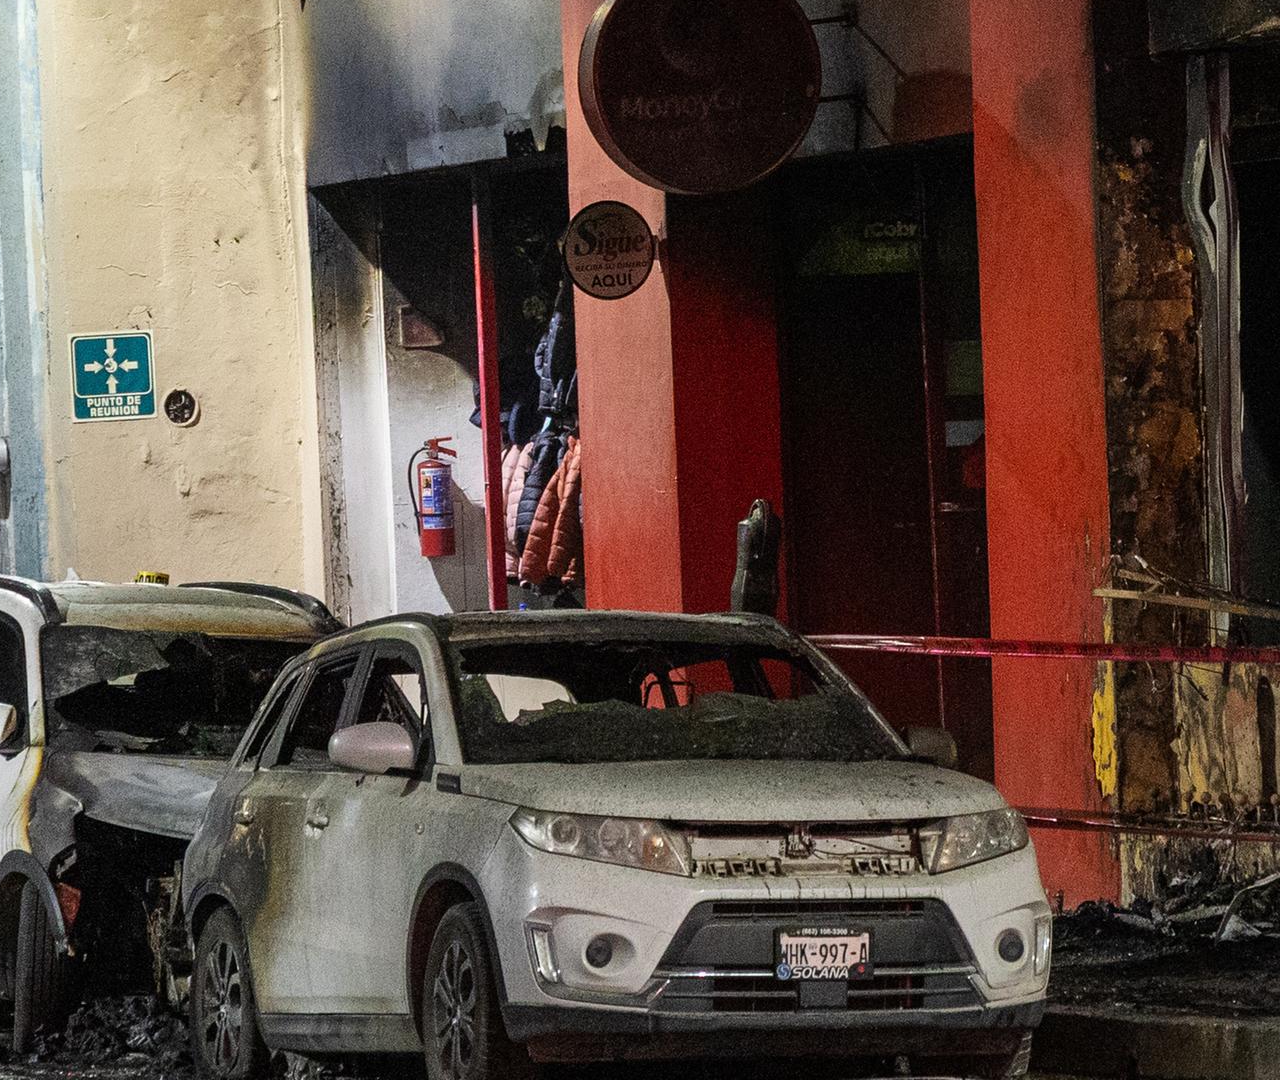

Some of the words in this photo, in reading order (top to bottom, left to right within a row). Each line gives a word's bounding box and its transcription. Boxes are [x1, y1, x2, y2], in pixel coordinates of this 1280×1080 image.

[620, 85, 744, 120] MoneyGr
[574, 219, 646, 262] Sigue
[592, 269, 633, 288] AQUÍ
[87, 396, 123, 408] PUNTO
[127, 395, 142, 406] DE
[90, 405, 140, 418] REUNION
[791, 966, 849, 980] SOLANA
